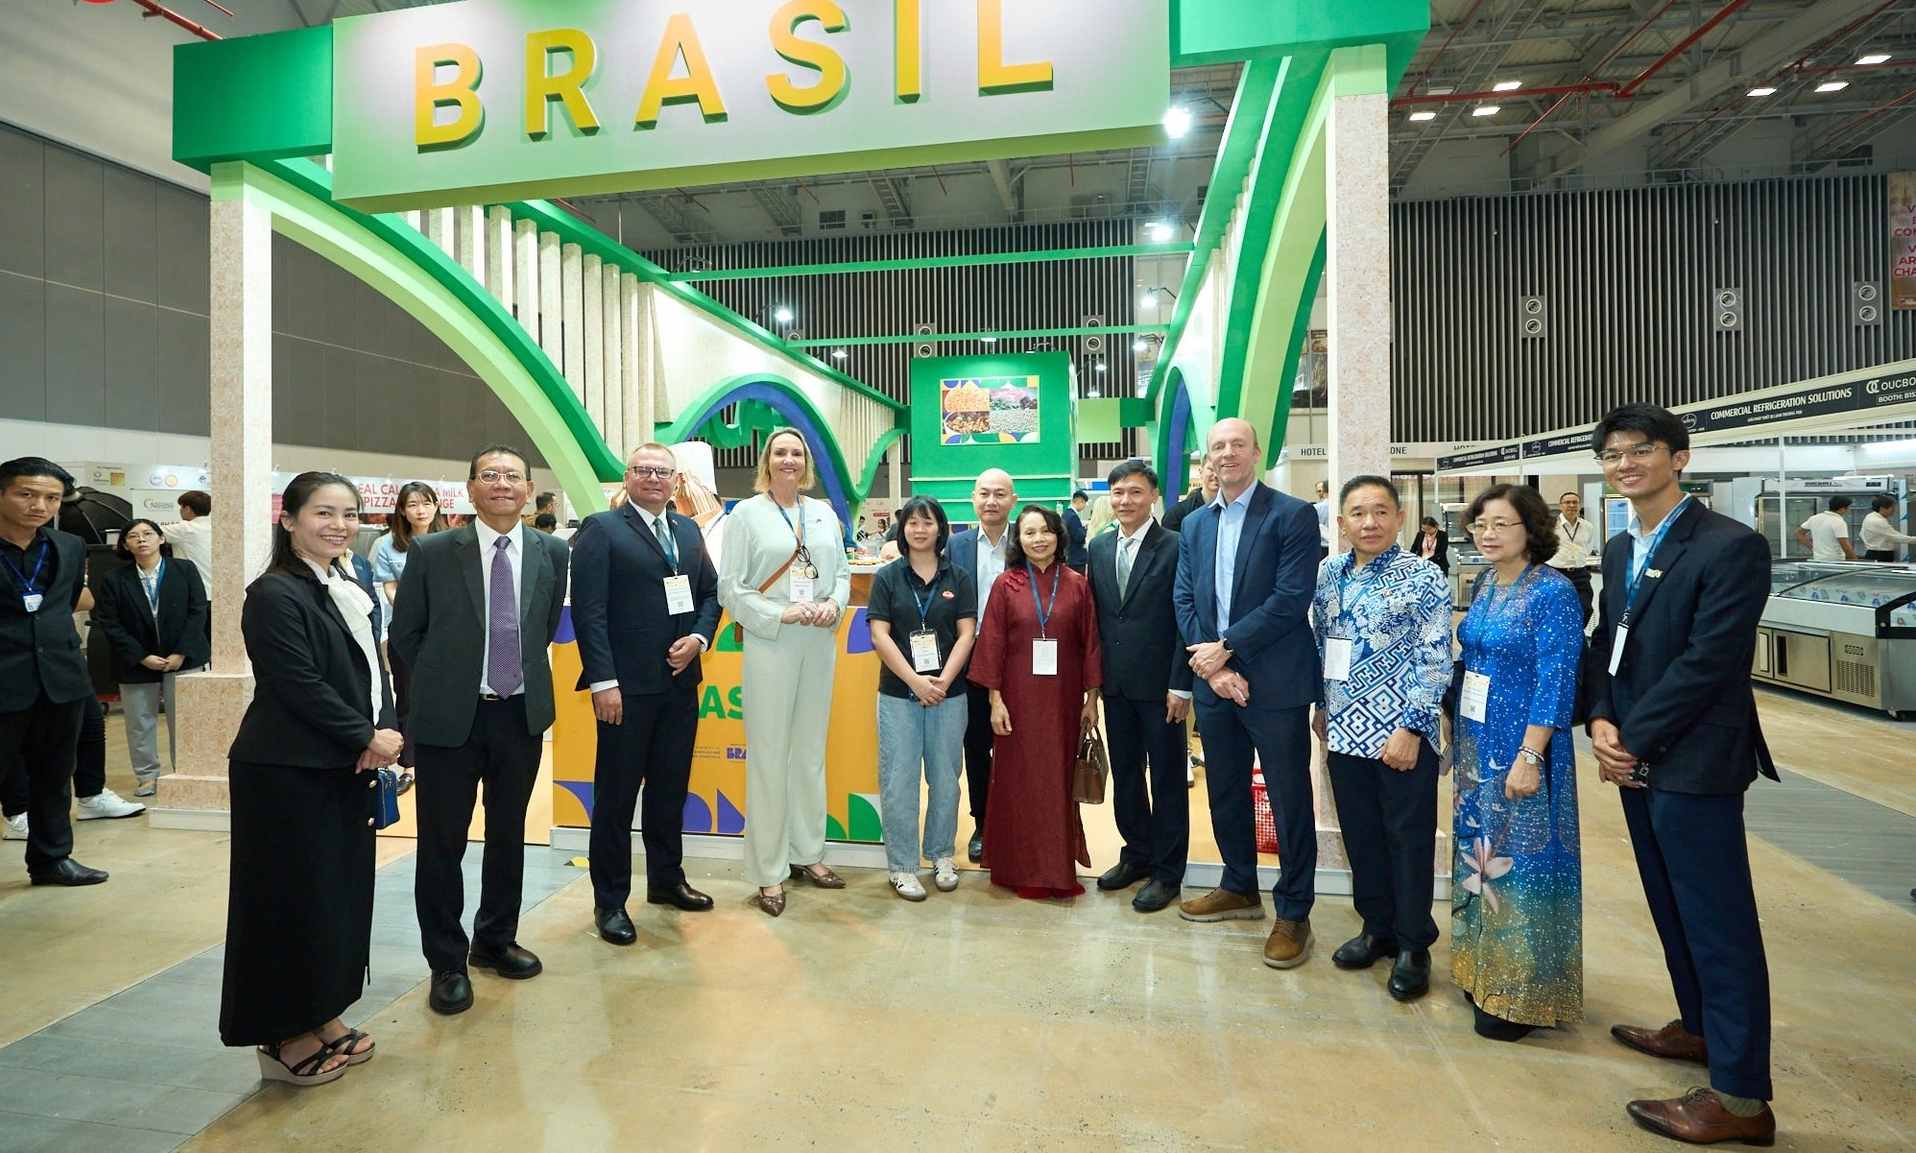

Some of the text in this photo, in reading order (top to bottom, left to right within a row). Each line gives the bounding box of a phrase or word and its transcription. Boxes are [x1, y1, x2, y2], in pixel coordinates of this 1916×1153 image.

[414, 0, 1054, 152] BRASIL
[1710, 405, 1752, 421] COMMERCIAL
[1753, 395, 1807, 414] REFRIGERATION
[1807, 387, 1853, 404] SOLUTIONS
[1300, 448, 1327, 456] HOTEL
[363, 496, 397, 507] PIZZA
